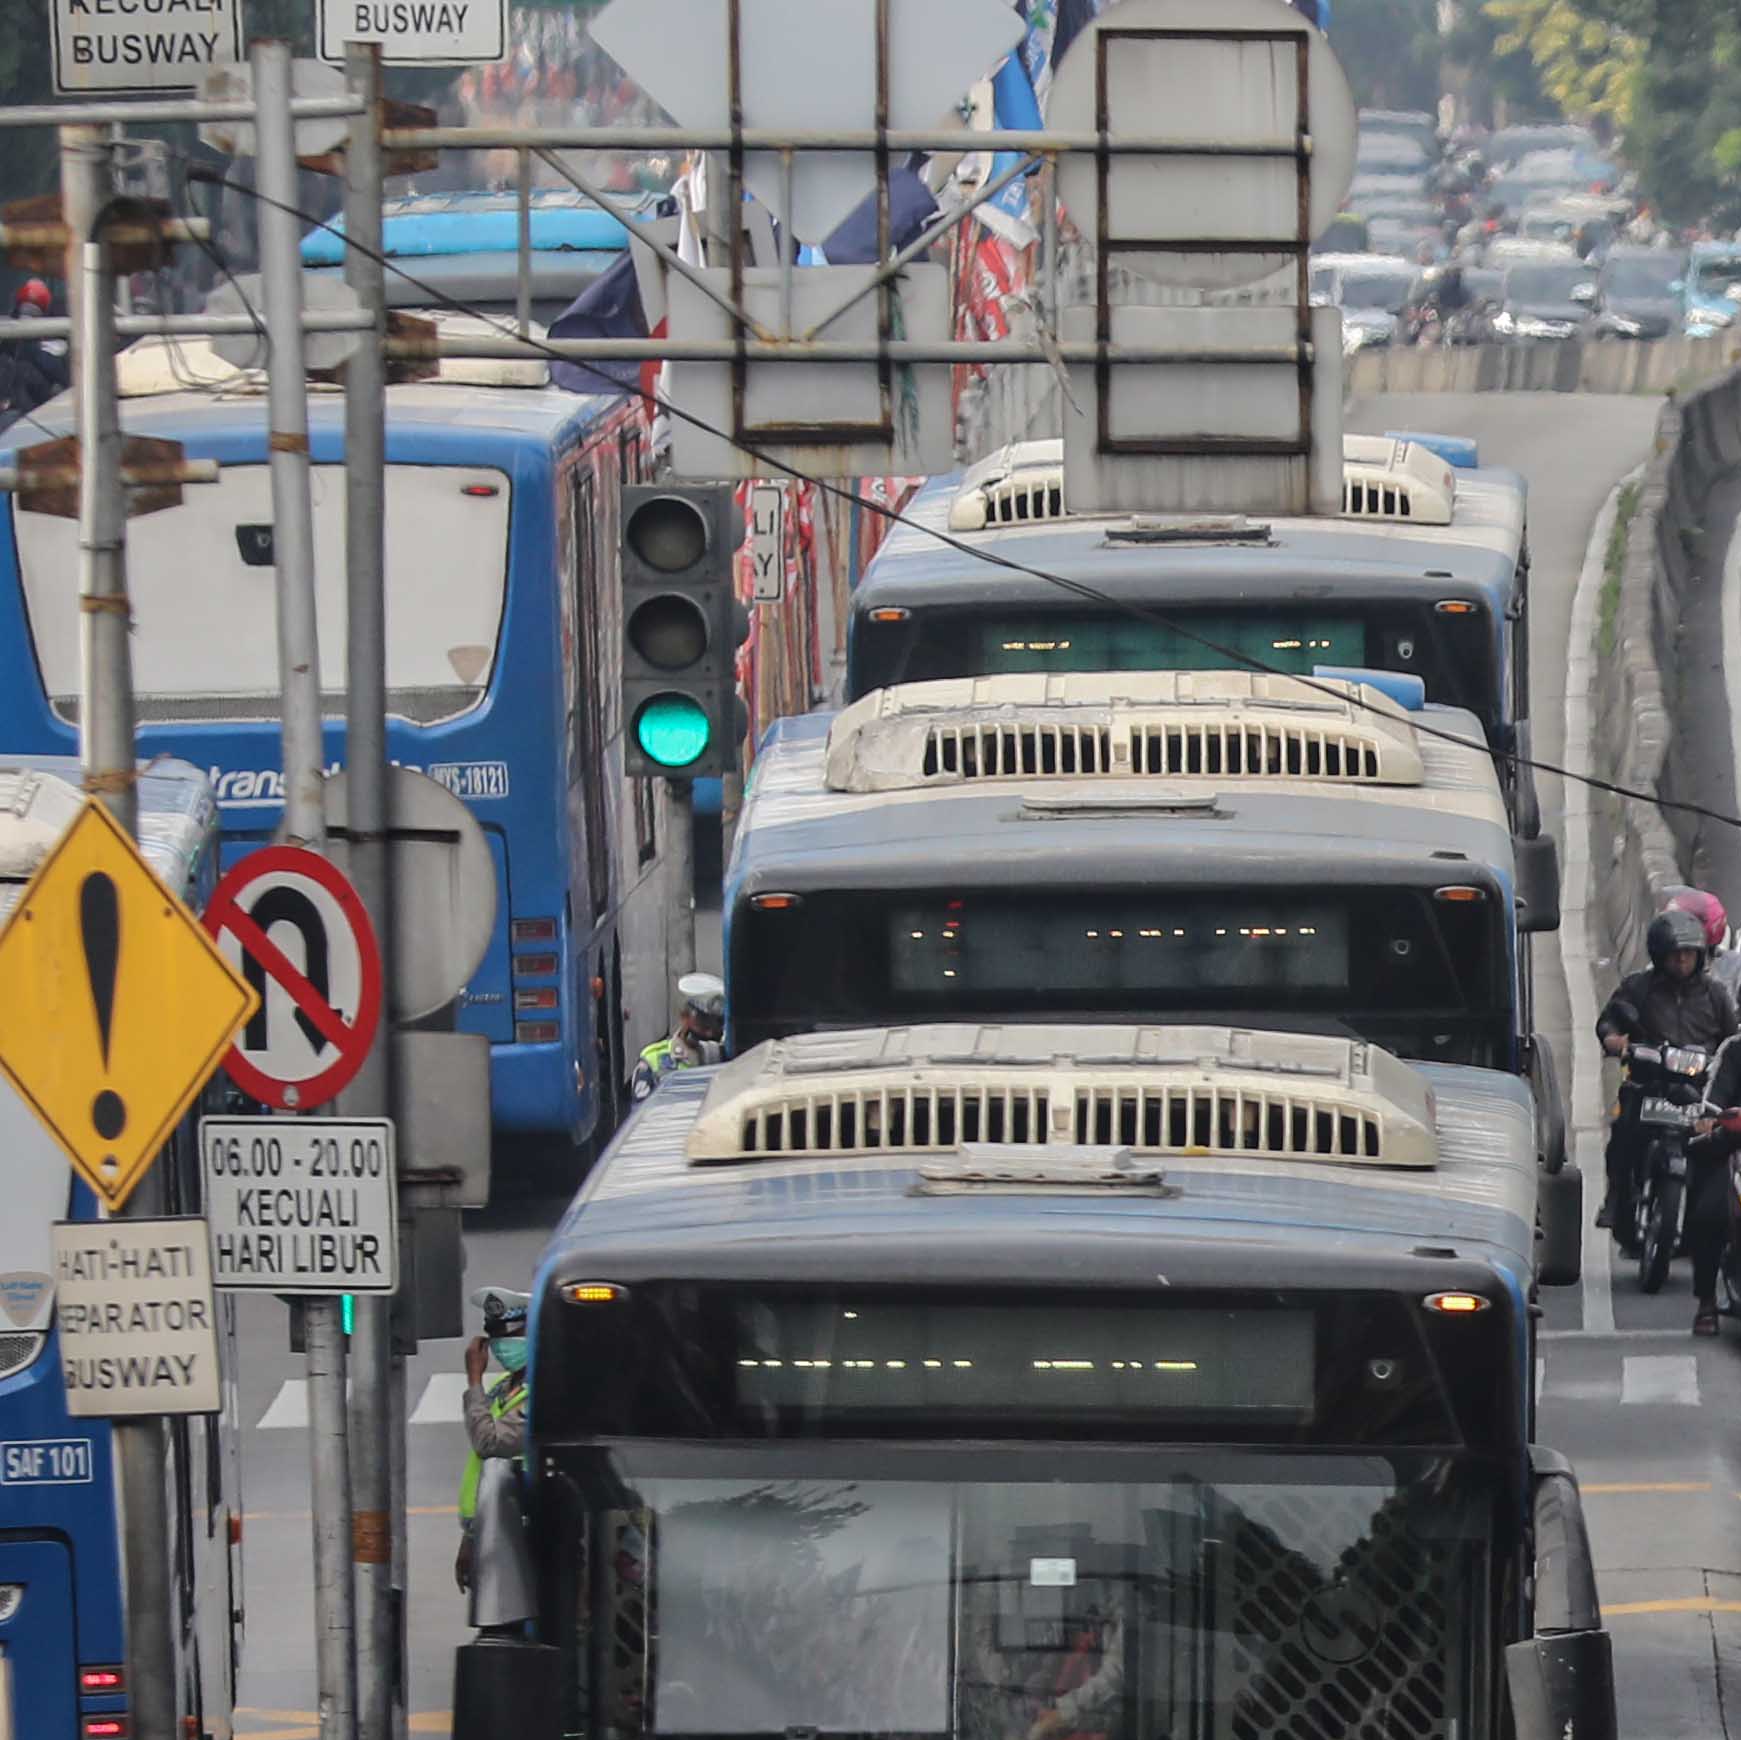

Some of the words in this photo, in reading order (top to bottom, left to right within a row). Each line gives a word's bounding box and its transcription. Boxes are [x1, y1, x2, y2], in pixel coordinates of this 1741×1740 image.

[355, 4, 468, 33] BUSWAY
[71, 34, 220, 64] BUSWAY
[212, 1138, 282, 1177] 06.00
[311, 1139, 382, 1178] 20.00
[238, 1188, 358, 1227] KECUALI
[217, 1234, 283, 1273] HARI
[294, 1234, 382, 1274] LIBUR
[7, 1449, 43, 1478] SAF
[50, 1446, 86, 1477] 101
